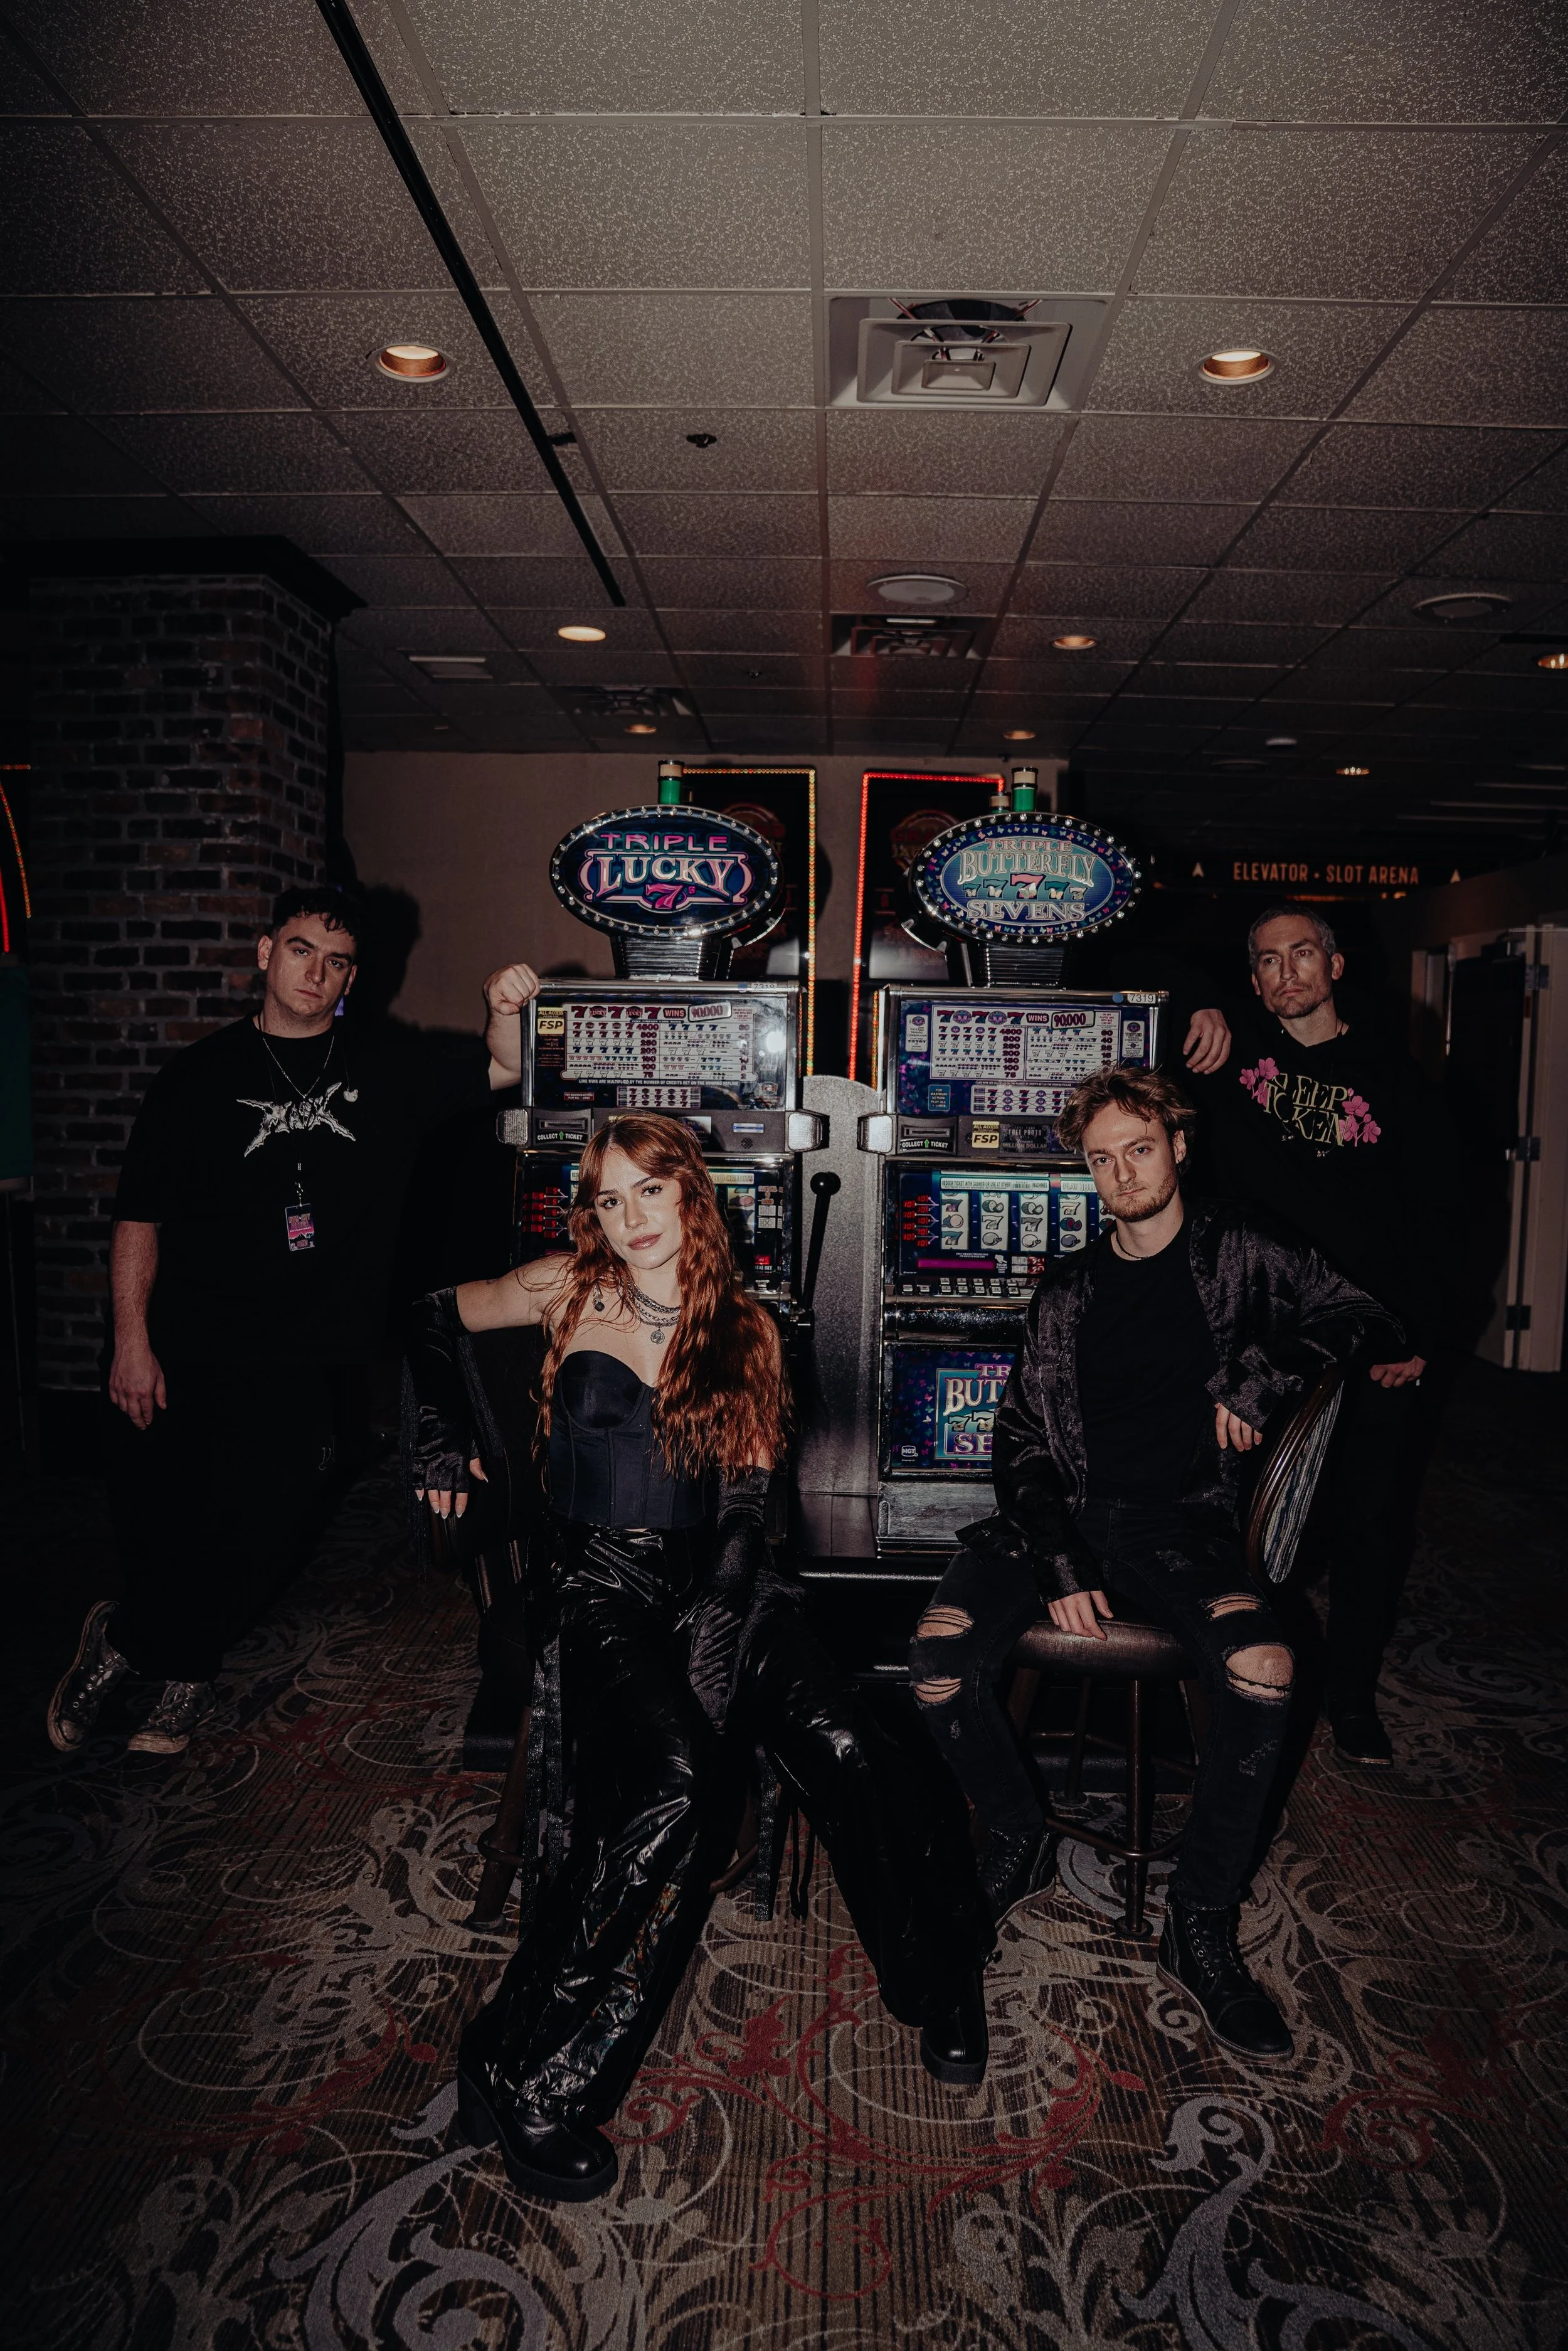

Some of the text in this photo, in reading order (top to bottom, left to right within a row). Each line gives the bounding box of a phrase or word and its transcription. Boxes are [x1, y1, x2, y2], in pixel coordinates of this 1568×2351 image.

[601, 834, 728, 852] TRIPLE
[985, 839, 1073, 852] TRIPLE
[594, 856, 737, 898] LUCKY
[958, 850, 1098, 888] BUTTERFLY
[1232, 861, 1419, 886] ELEVATOR SLOT ARENA
[1009, 873, 1047, 900] 7
[967, 900, 1087, 920] SEVENS
[1130, 994, 1154, 1003] 7319
[665, 1009, 684, 1017] WINS
[539, 1021, 563, 1029] FSP
[1271, 1072, 1349, 1112] SEEP
[537, 1133, 583, 1141] COLLECT TICKET
[901, 1140, 924, 1149] COLLECT
[973, 1134, 998, 1143] FSP
[975, 1362, 1012, 1379] TR
[954, 1433, 993, 1455] SE
